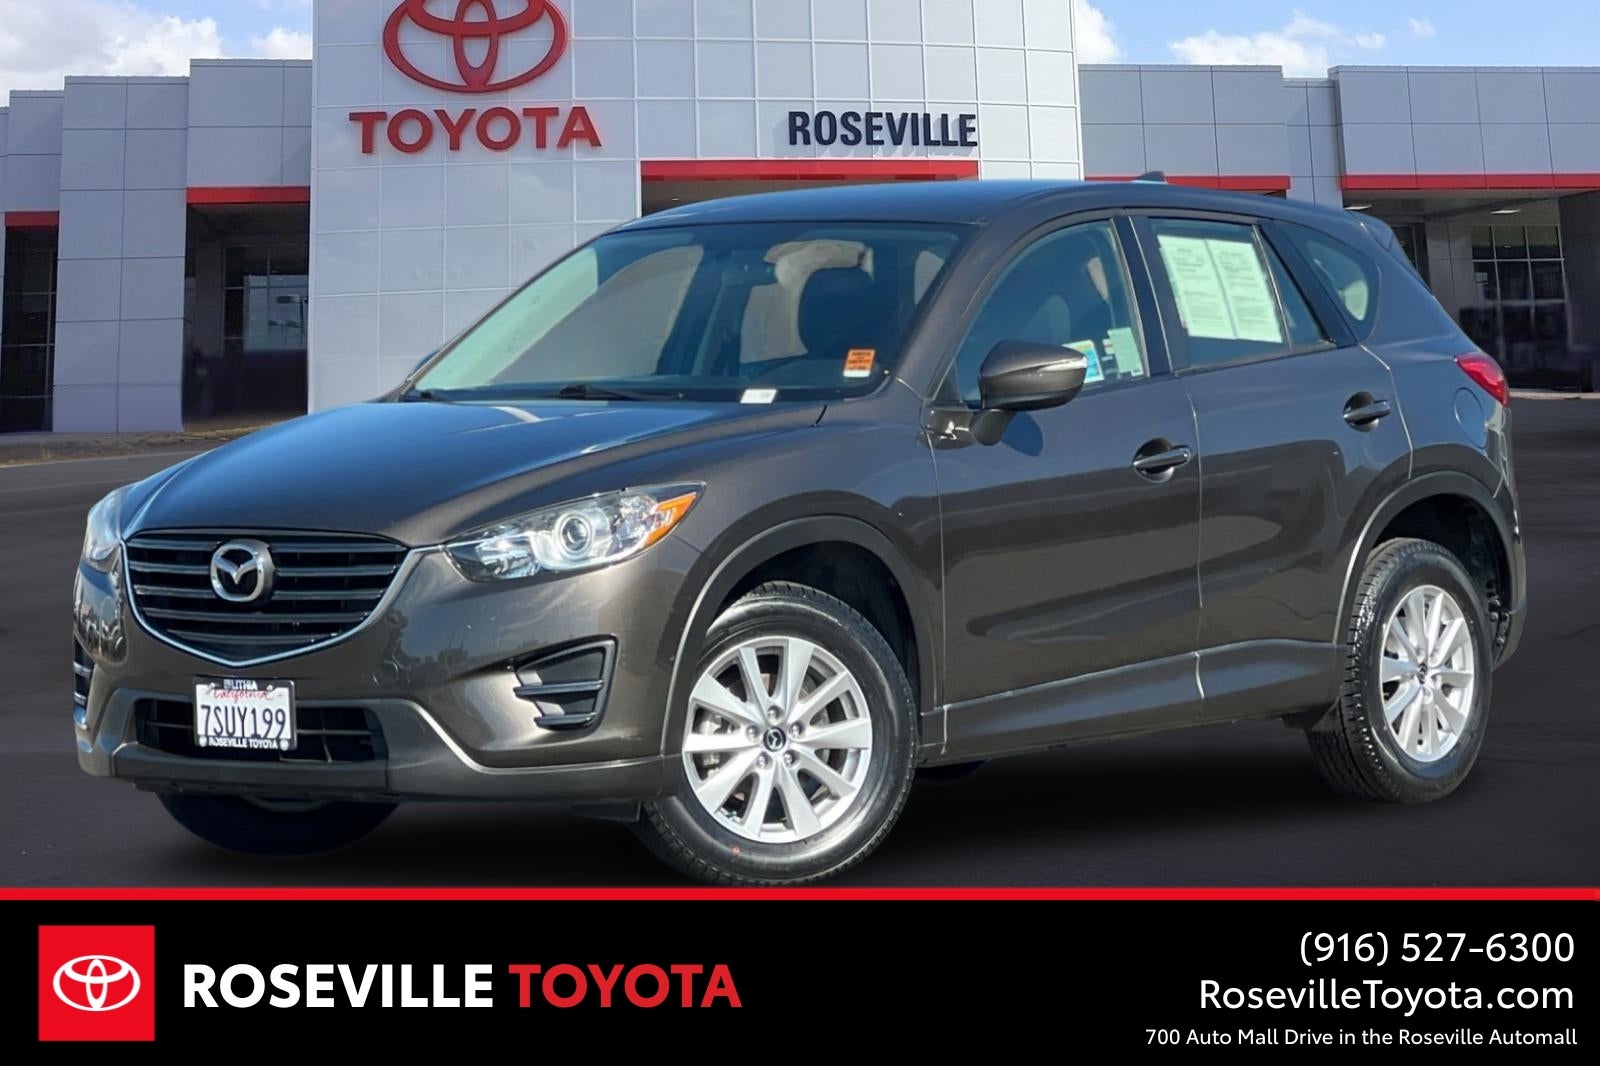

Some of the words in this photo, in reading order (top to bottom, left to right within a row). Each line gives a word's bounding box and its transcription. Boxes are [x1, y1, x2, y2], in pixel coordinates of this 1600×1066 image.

[349, 105, 602, 154] TOYOTA
[788, 111, 978, 147] ROSEVILLE
[201, 704, 286, 739] 7SUY199
[208, 738, 248, 748] ROSEVILLE
[249, 738, 279, 750] TOYOTA
